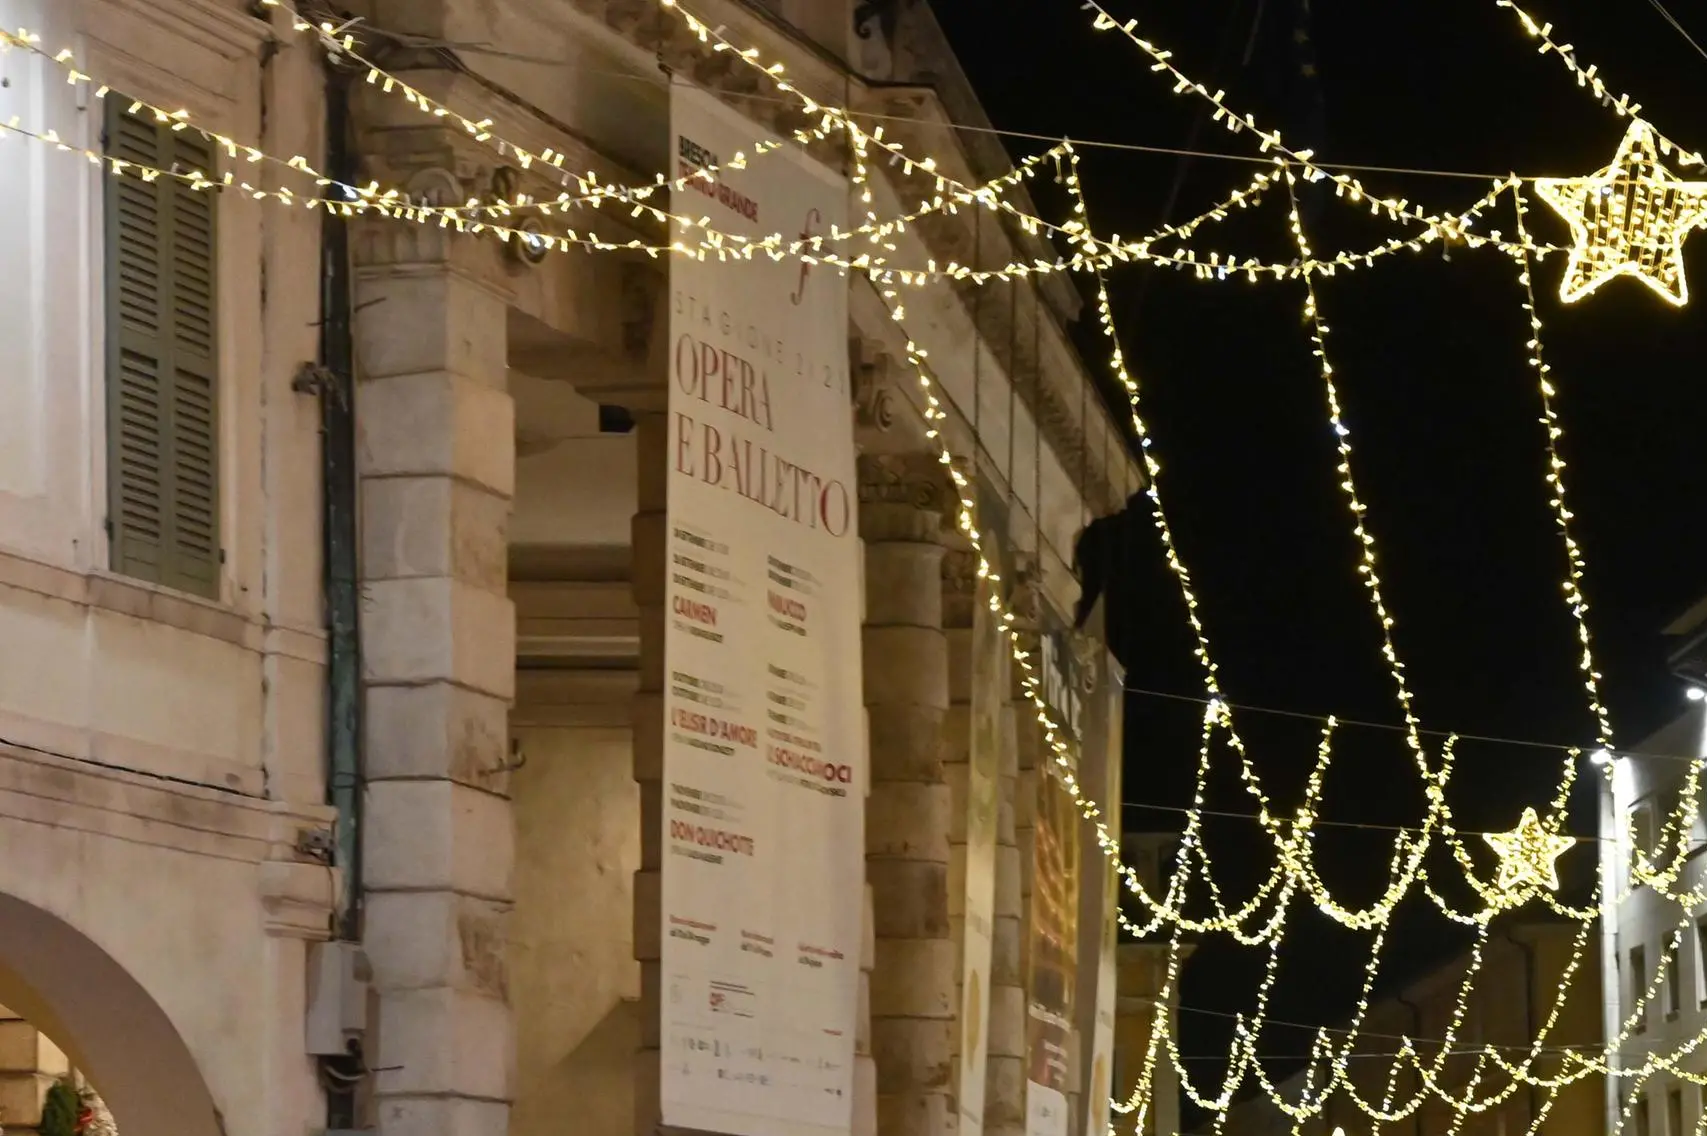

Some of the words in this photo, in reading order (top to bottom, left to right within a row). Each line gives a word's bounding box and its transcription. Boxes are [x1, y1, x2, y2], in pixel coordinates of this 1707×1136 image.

[676, 333, 774, 432] OPERA
[675, 411, 695, 478] E
[701, 422, 849, 537] BALLETTO
